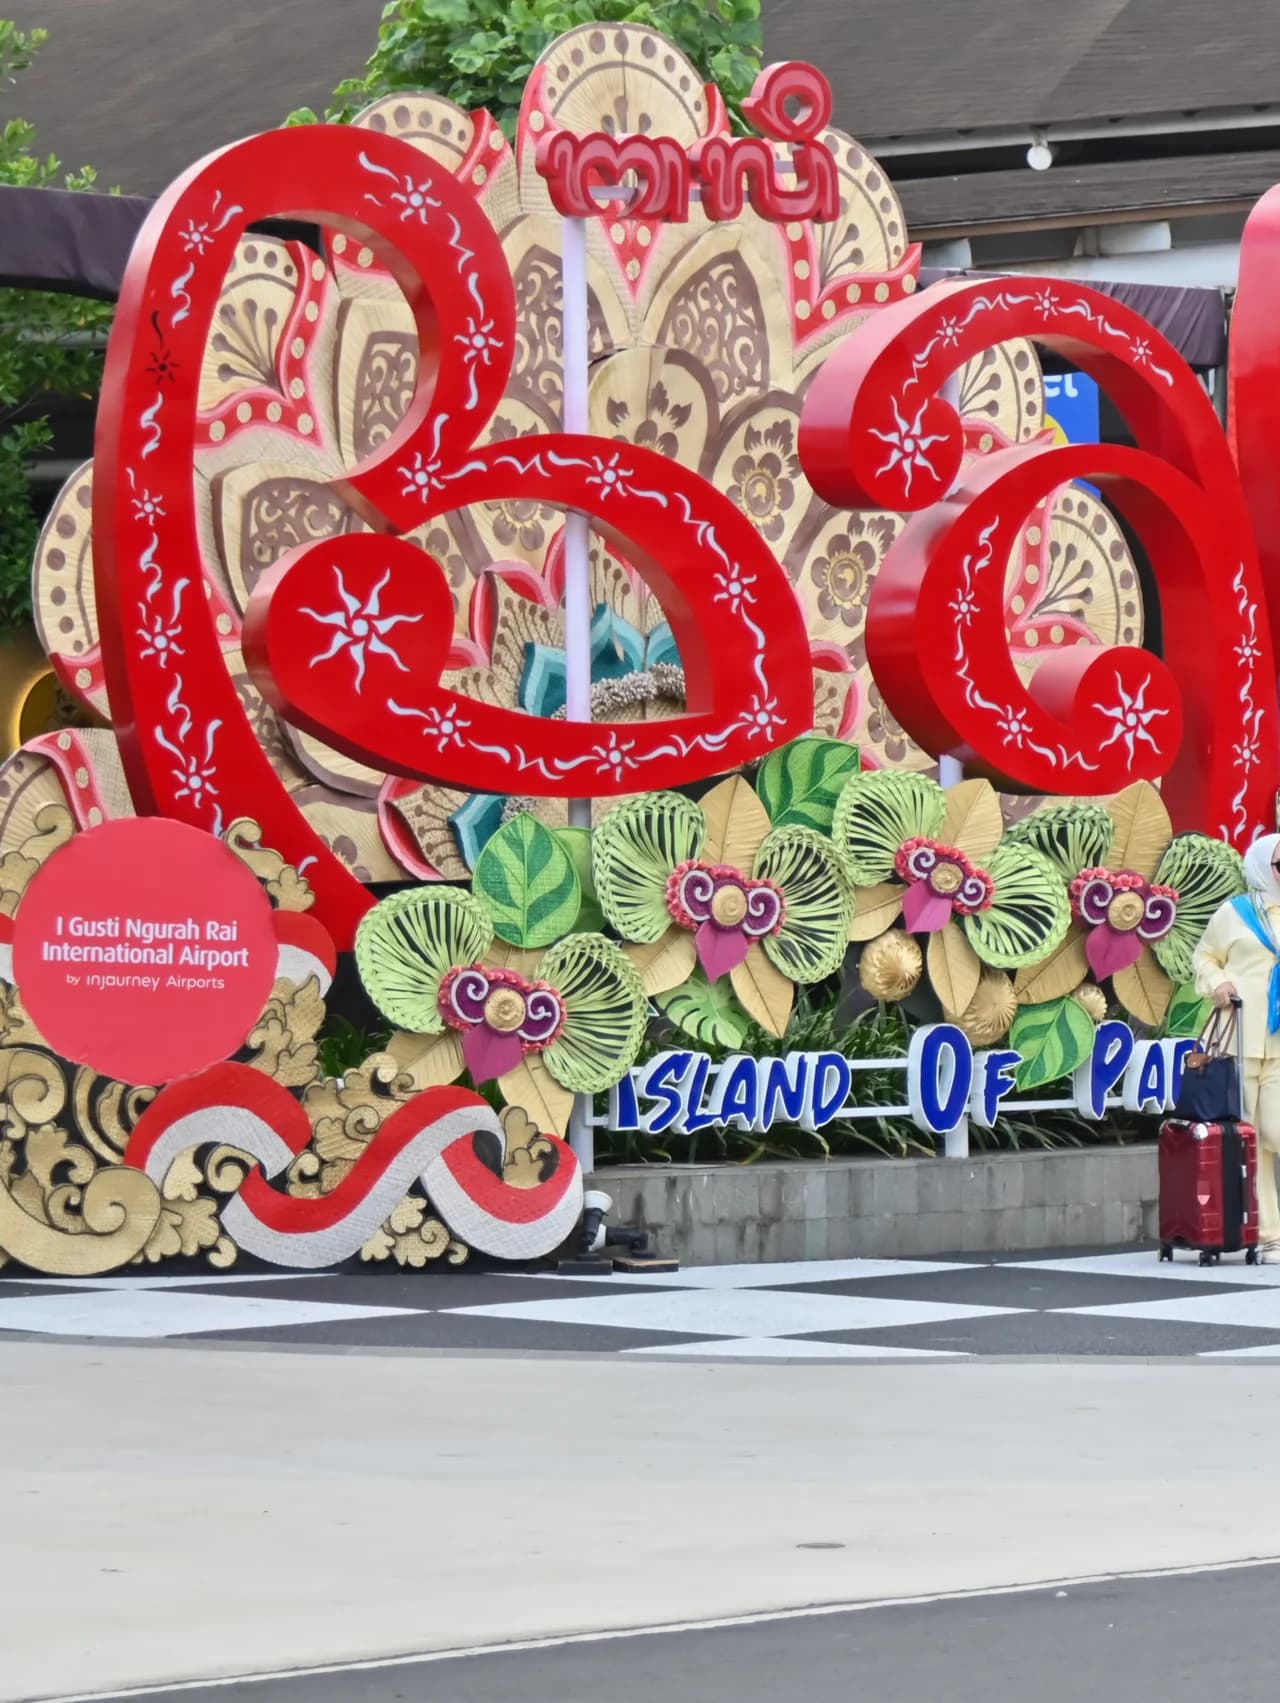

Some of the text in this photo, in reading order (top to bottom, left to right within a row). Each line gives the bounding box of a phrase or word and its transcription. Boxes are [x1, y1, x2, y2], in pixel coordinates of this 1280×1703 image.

[55, 916, 238, 944] I Gusti Ngurah Rai
[42, 941, 249, 971] International Airport
[66, 974, 80, 985] by
[166, 975, 225, 990] Airports
